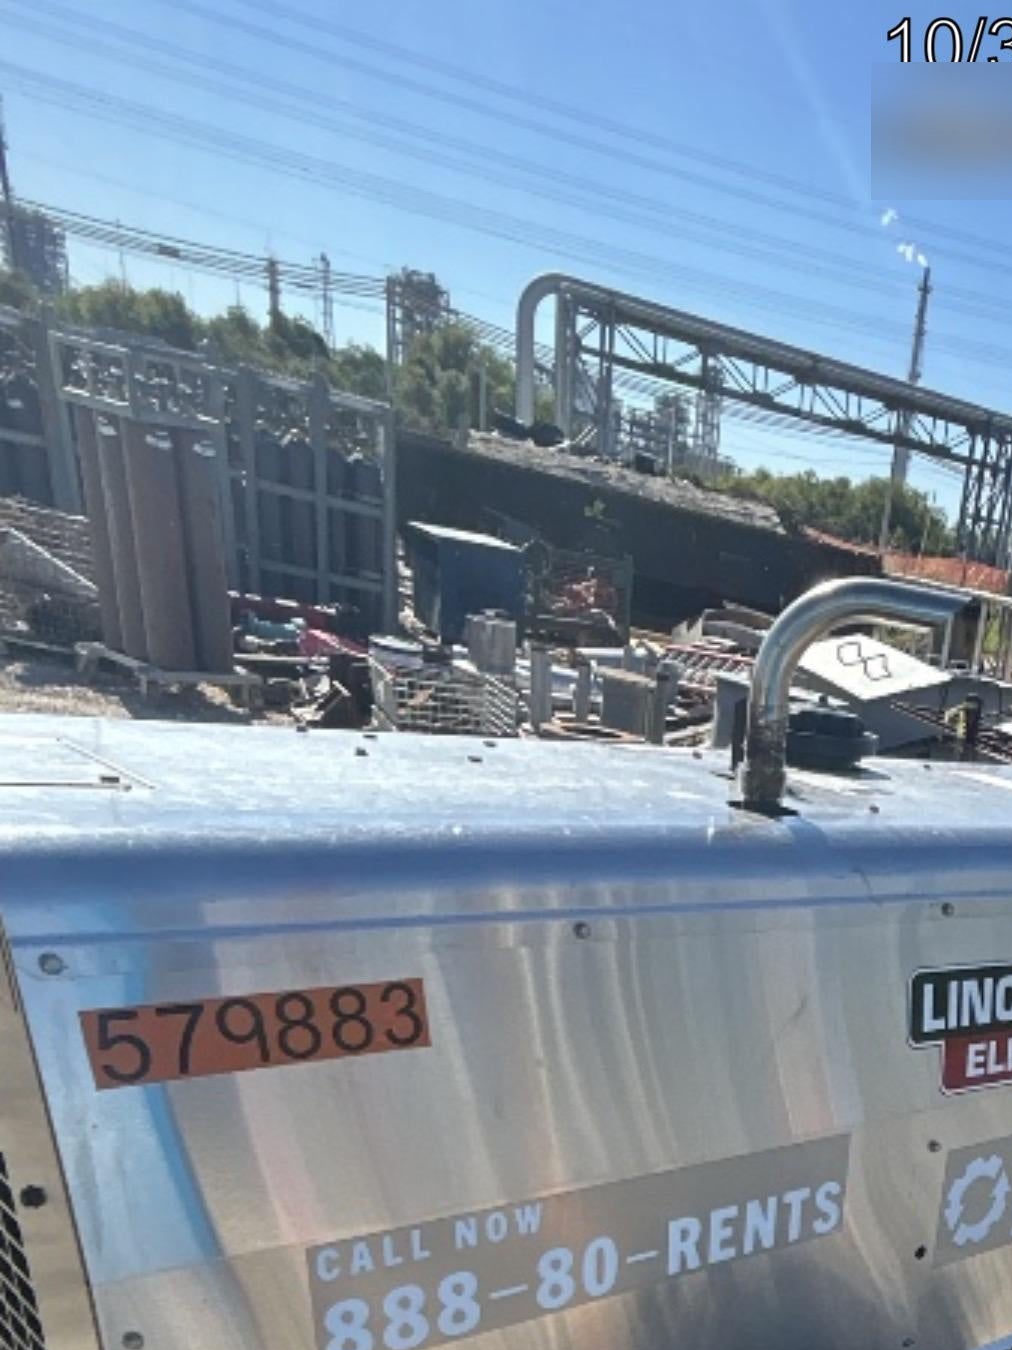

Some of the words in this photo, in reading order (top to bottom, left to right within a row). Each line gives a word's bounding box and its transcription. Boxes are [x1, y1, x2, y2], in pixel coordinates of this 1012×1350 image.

[97, 981, 424, 1082] 579883
[316, 1220, 431, 1282] CALL
[454, 1203, 544, 1250] NOW
